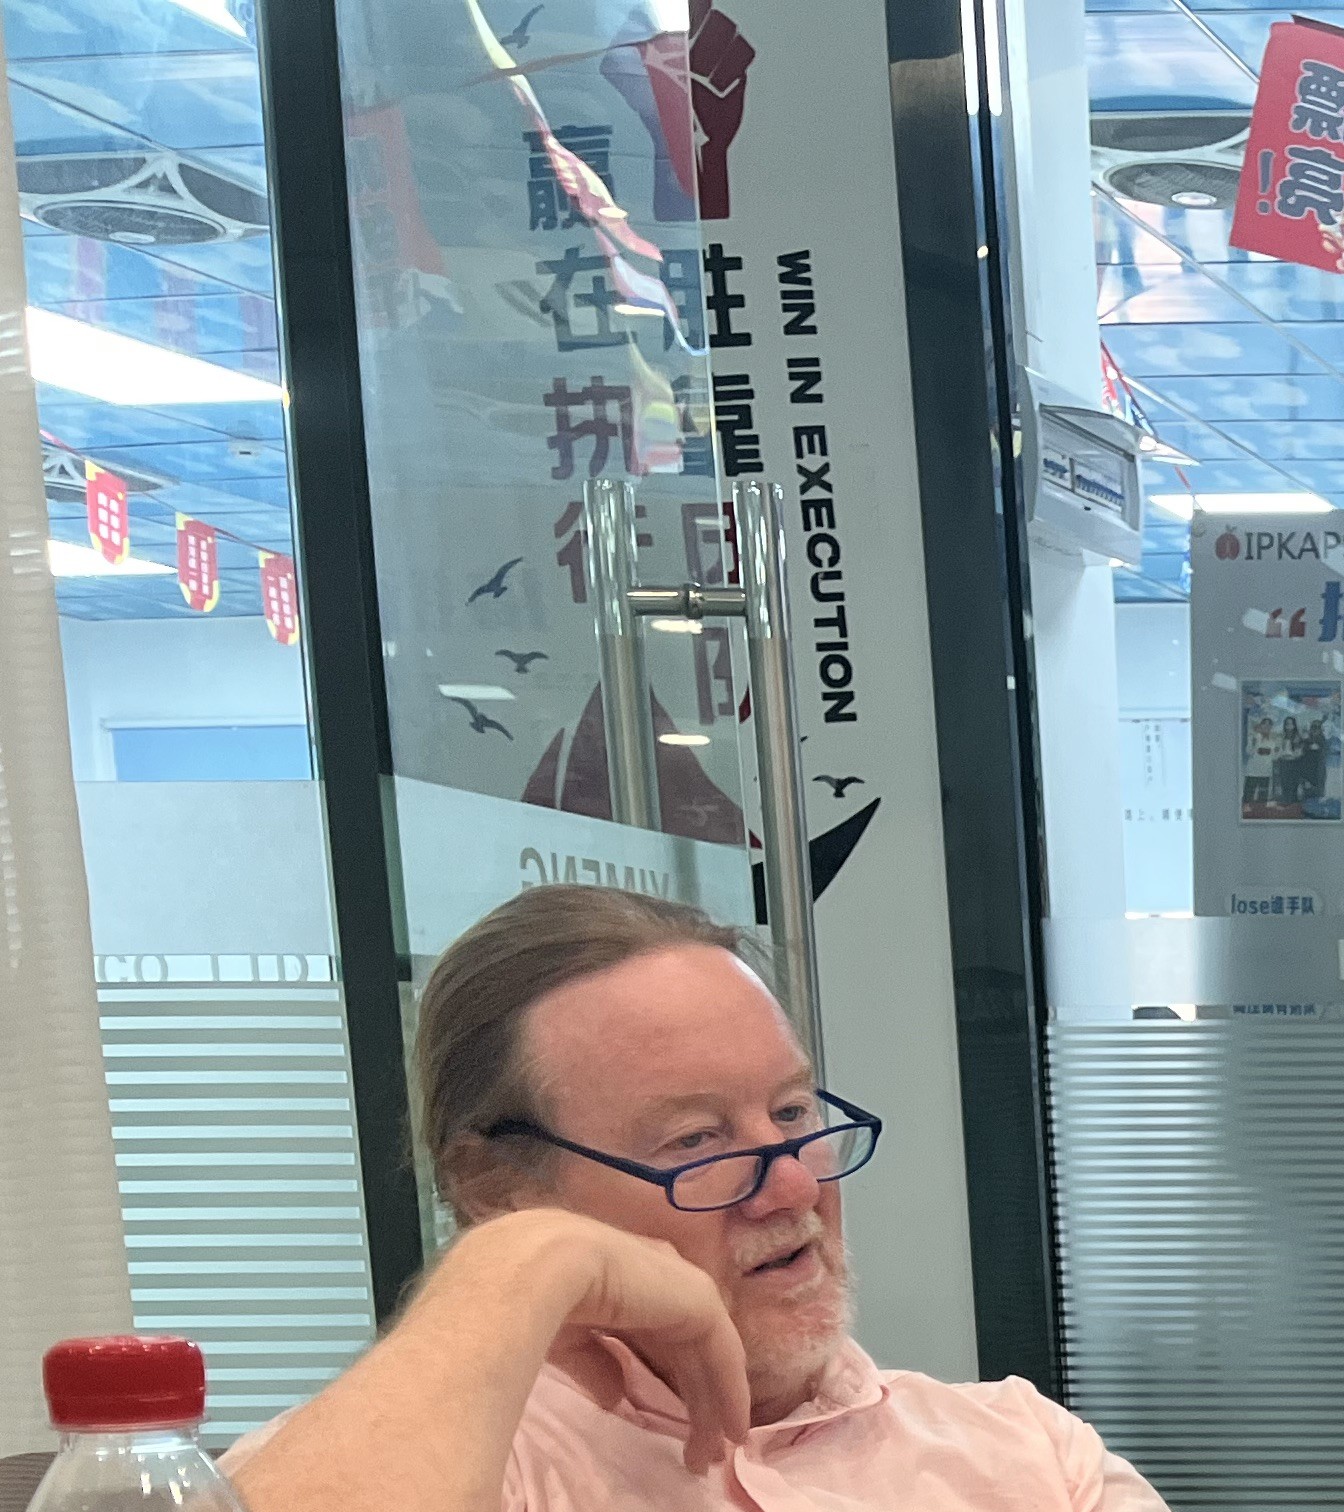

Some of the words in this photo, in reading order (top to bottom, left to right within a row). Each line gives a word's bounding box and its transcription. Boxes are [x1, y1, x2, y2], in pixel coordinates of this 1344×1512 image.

[777, 249, 818, 336] WIN
[786, 357, 824, 404] IN
[792, 424, 858, 723] EXECUTION
